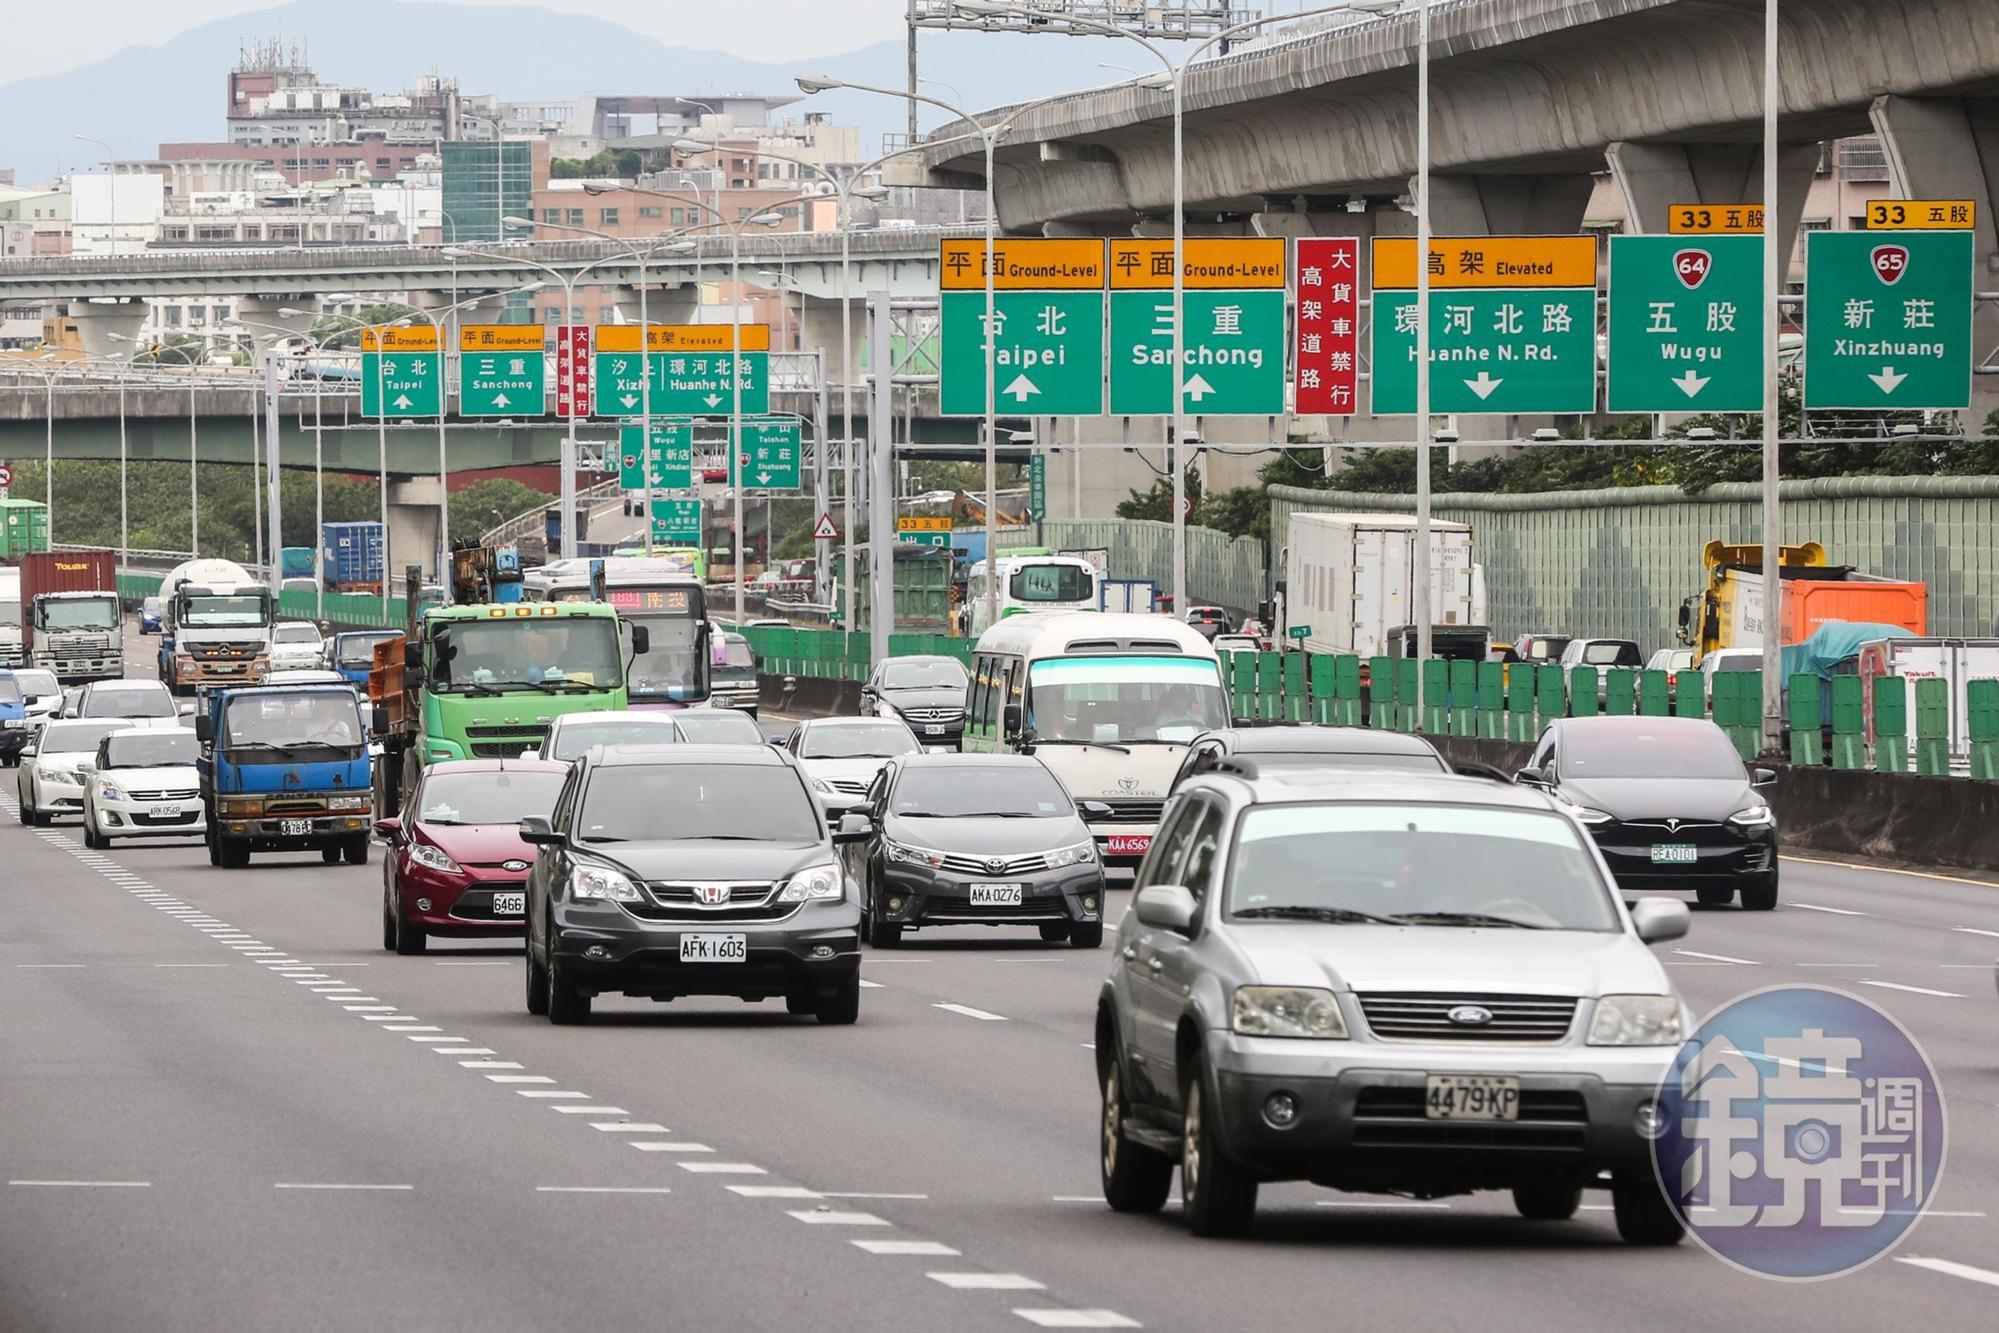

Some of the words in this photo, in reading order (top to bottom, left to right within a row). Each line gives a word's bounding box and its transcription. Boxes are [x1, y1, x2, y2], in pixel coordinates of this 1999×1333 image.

[1681, 210, 1712, 228] 33
[1725, 210, 1765, 228] 五股
[1874, 206, 1905, 225] 33
[1929, 206, 1968, 223] 五股
[946, 252, 1006, 277] 平面
[1010, 264, 1097, 277] Ground-Level
[1116, 251, 1175, 277] 平面
[1184, 264, 1279, 277] Ground-Level
[1428, 250, 1484, 276] 高架
[1496, 261, 1553, 275] Elevated
[1678, 256, 1705, 274] 64
[1876, 254, 1902, 271] 65
[977, 305, 1067, 336] 台北
[1151, 304, 1243, 335] 三重
[1394, 303, 1573, 335] 環河北路
[1646, 301, 1737, 334] 五股
[1843, 299, 1935, 329] 新莊
[1301, 266, 1322, 389] 高架道路
[1331, 248, 1352, 405] 大貨車禁行
[365, 331, 396, 345] 平面
[397, 337, 443, 345] Ground-Levl
[463, 331, 495, 345] 平面
[646, 331, 674, 344] 高架
[1525, 344, 1558, 361] Rd.
[1661, 343, 1722, 363] Wugu
[1833, 339, 1944, 359] Xinzhuang
[381, 359, 427, 376] 台北
[479, 358, 526, 375] 三重
[669, 359, 753, 375] 環河北路
[386, 380, 422, 391] Taipei
[472, 380, 533, 390] Sanchong
[670, 379, 717, 390] Huanhe
[901, 519, 917, 529] 33
